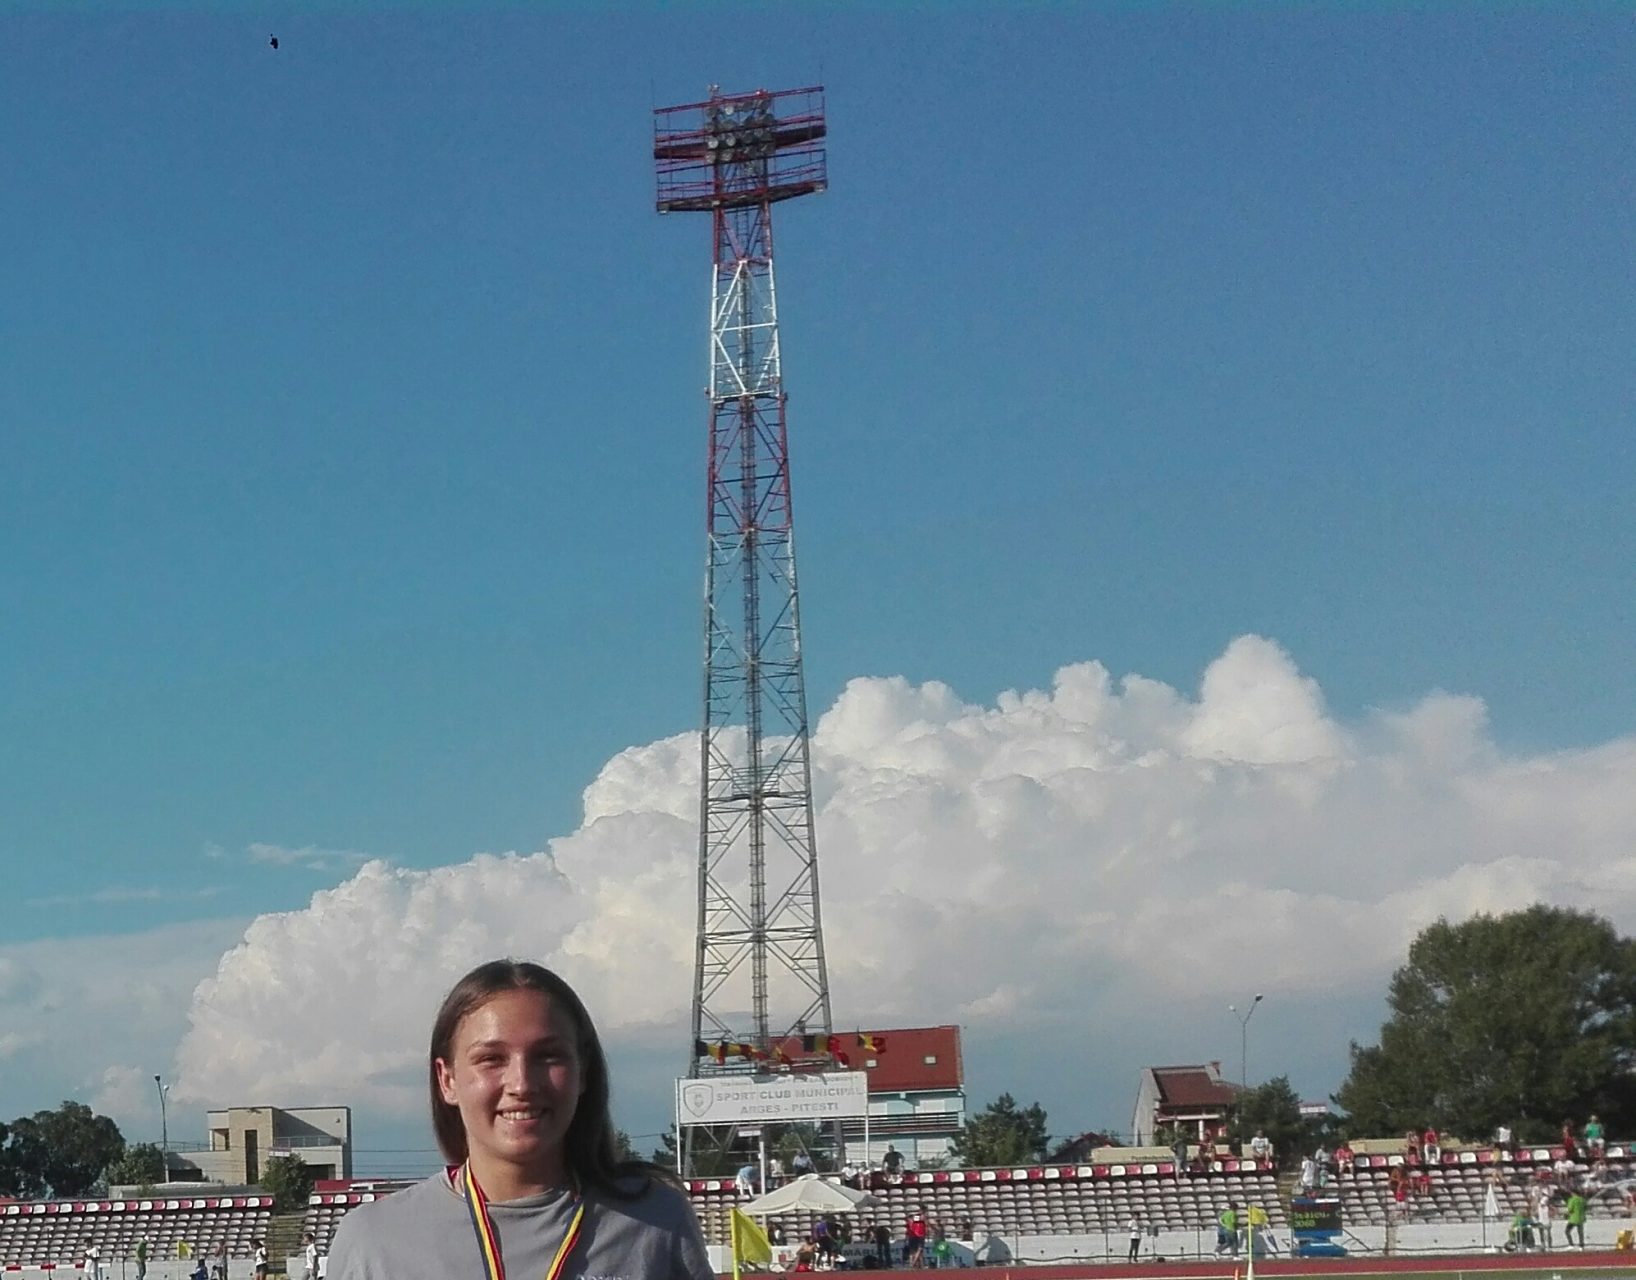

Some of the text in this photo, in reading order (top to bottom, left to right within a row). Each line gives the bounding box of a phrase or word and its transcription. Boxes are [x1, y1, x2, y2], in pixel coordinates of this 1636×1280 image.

[717, 1087, 864, 1102] SPORT CLUB MUNICIPAL
